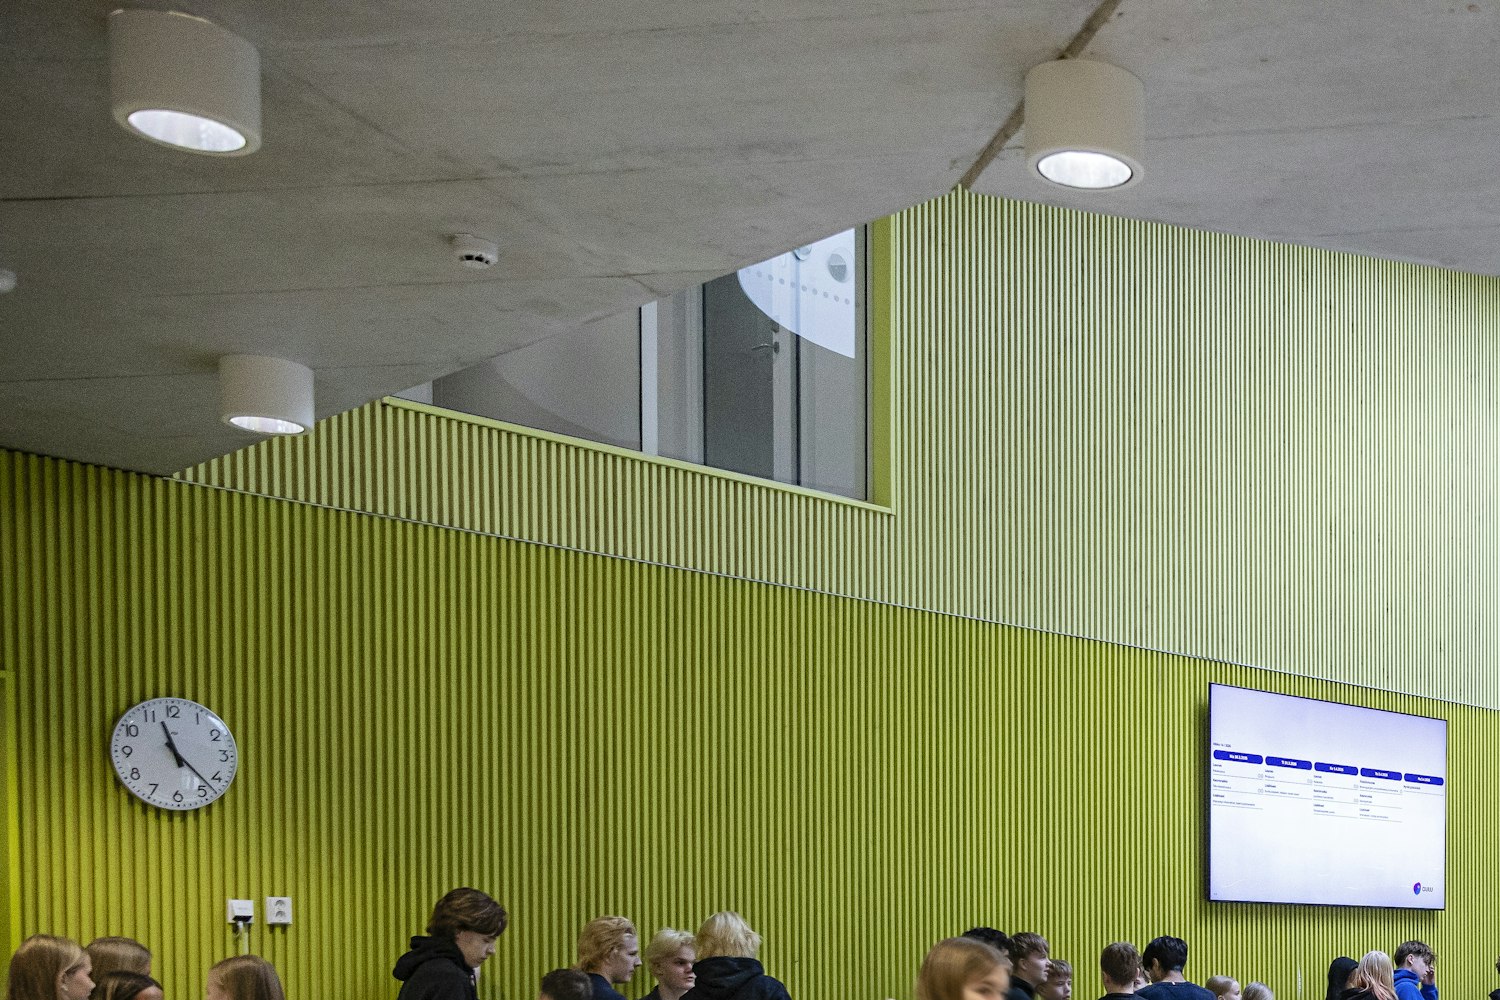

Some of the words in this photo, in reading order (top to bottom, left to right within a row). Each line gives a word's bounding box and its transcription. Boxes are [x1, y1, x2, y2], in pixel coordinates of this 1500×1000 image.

[144, 709, 156, 723] 11
[166, 705, 180, 718] 12
[195, 712, 200, 725] 1
[125, 724, 139, 737] 10
[210, 729, 221, 742] 2
[121, 745, 133, 758] 9
[218, 749, 229, 762] 3
[130, 767, 141, 780] 8
[211, 771, 222, 783] 4
[148, 783, 159, 796] 7
[197, 785, 208, 798] 5
[172, 790, 184, 803] 6
